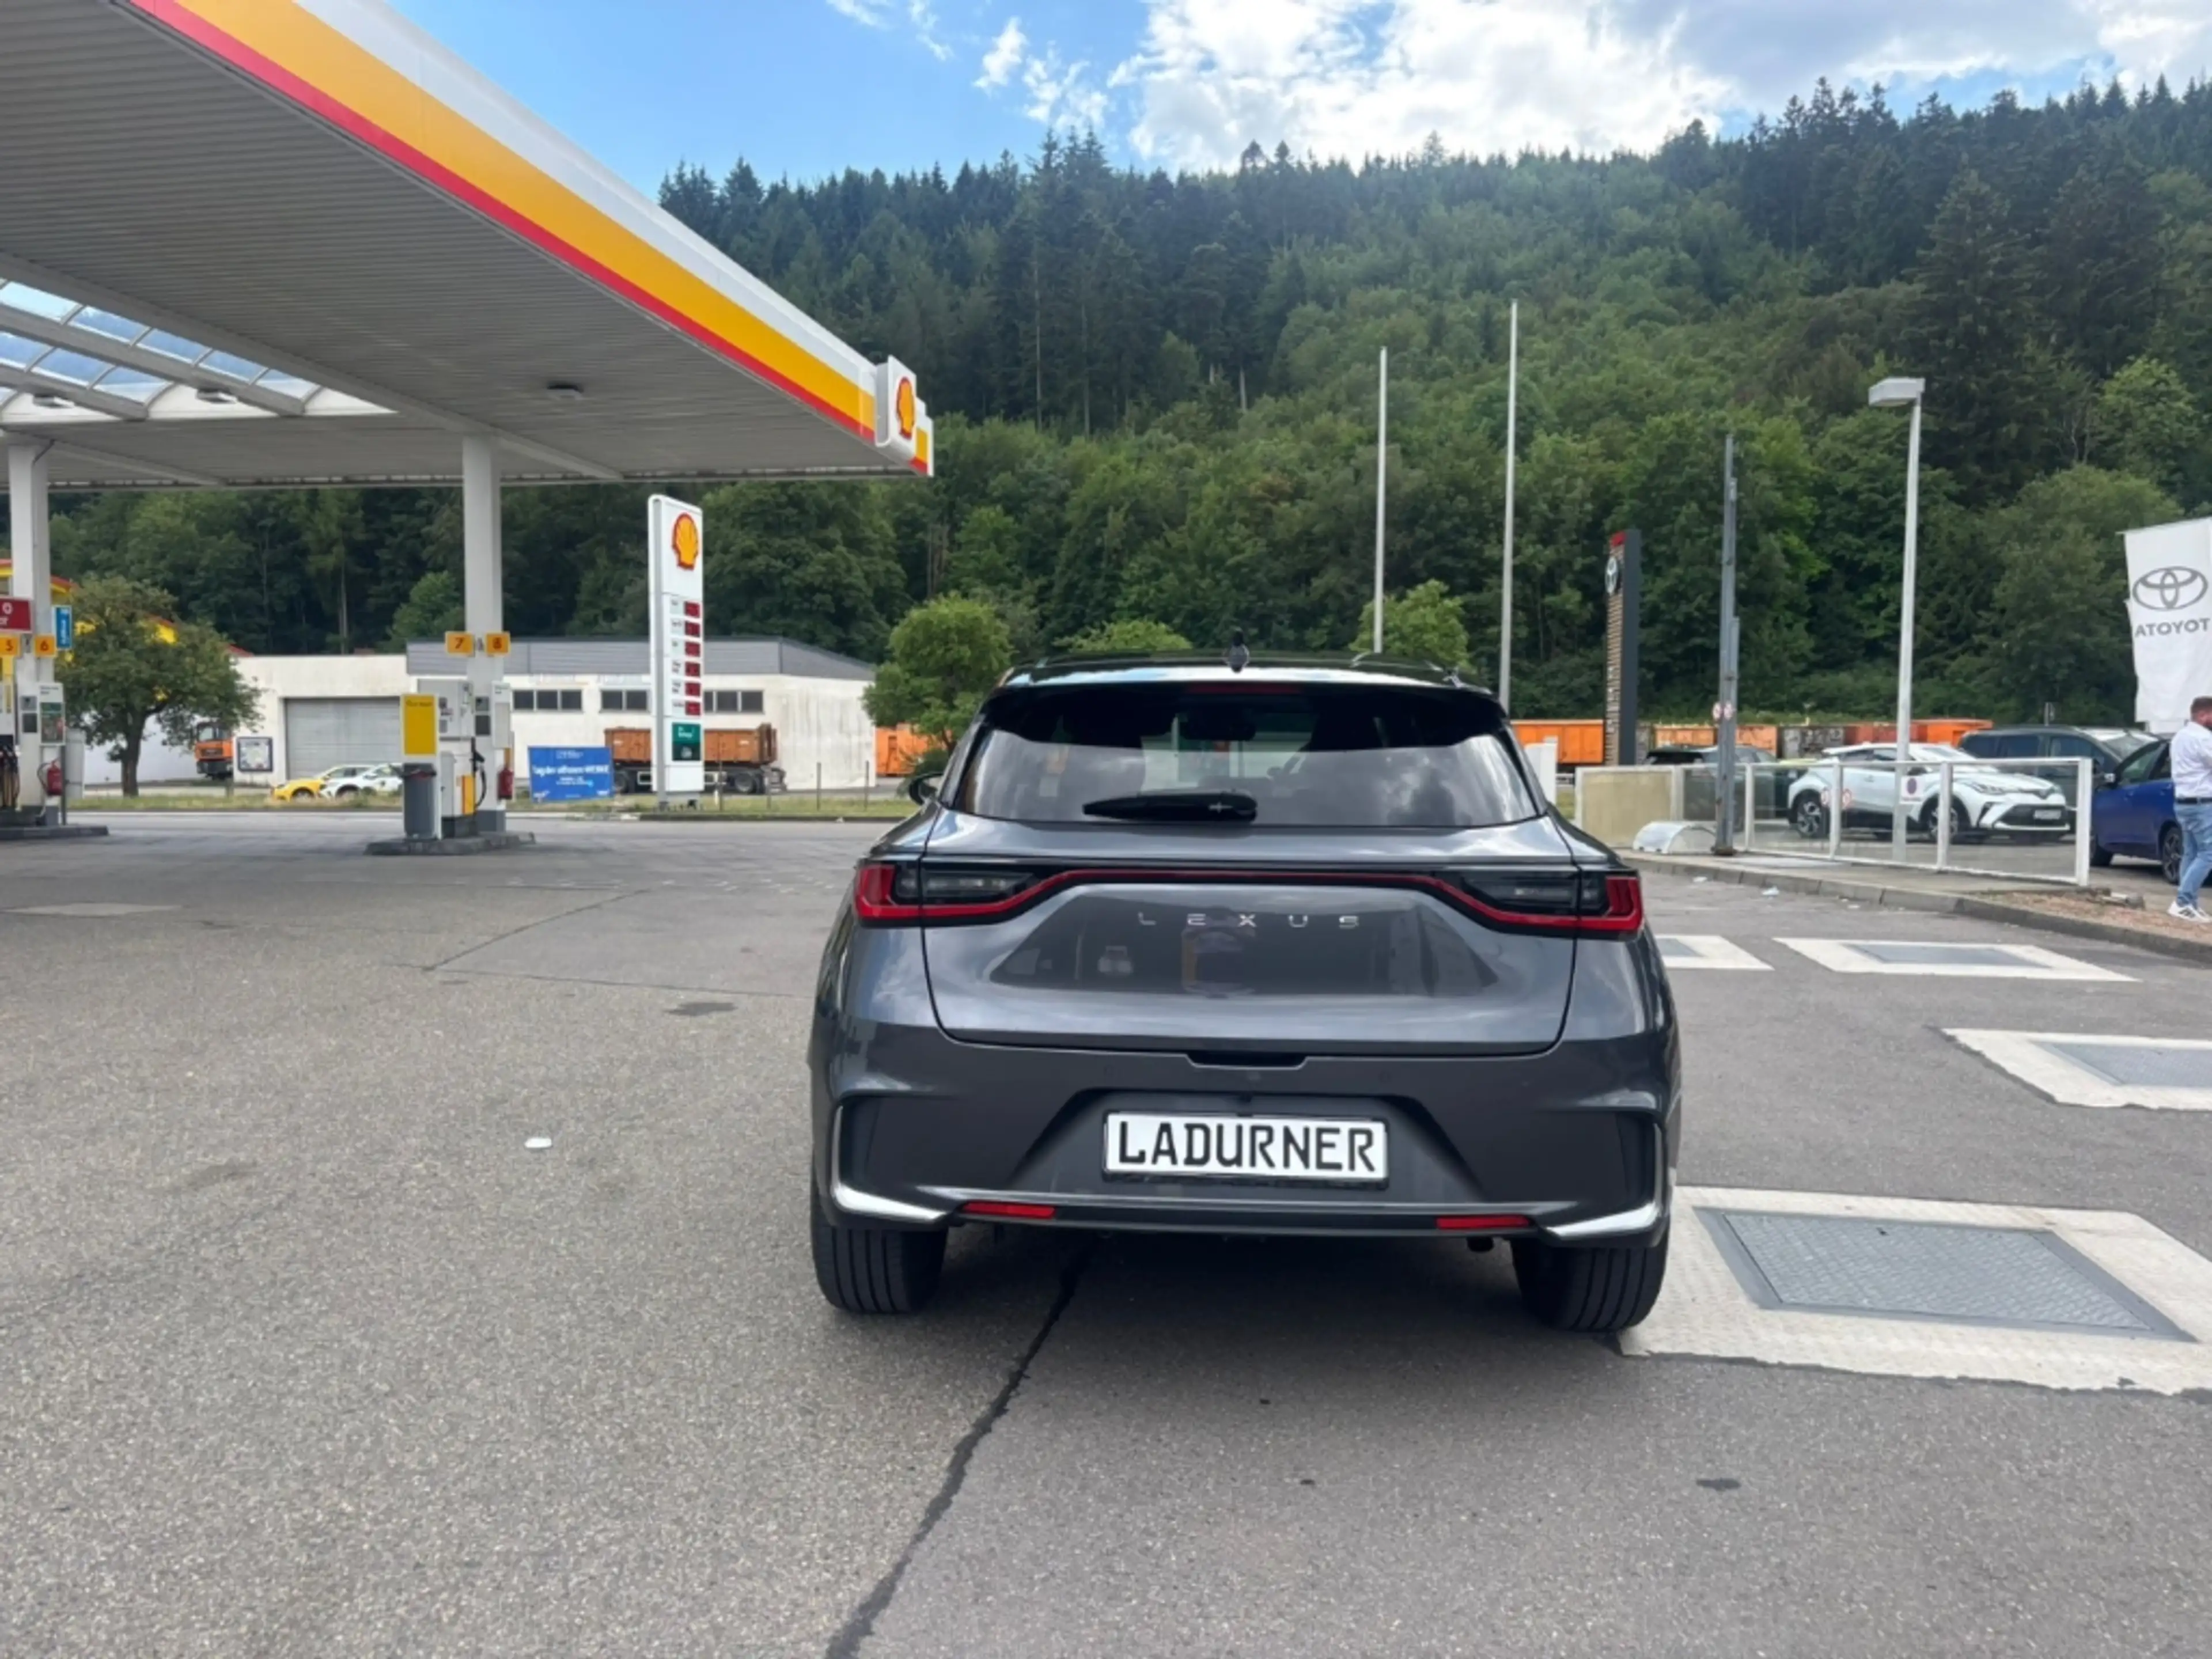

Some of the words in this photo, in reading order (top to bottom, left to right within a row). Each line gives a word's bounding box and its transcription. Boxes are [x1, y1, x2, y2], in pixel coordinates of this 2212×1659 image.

[39, 640, 50, 652] 6
[1138, 911, 1359, 929] LEXUS
[1118, 1120, 1375, 1173] LADURNER
